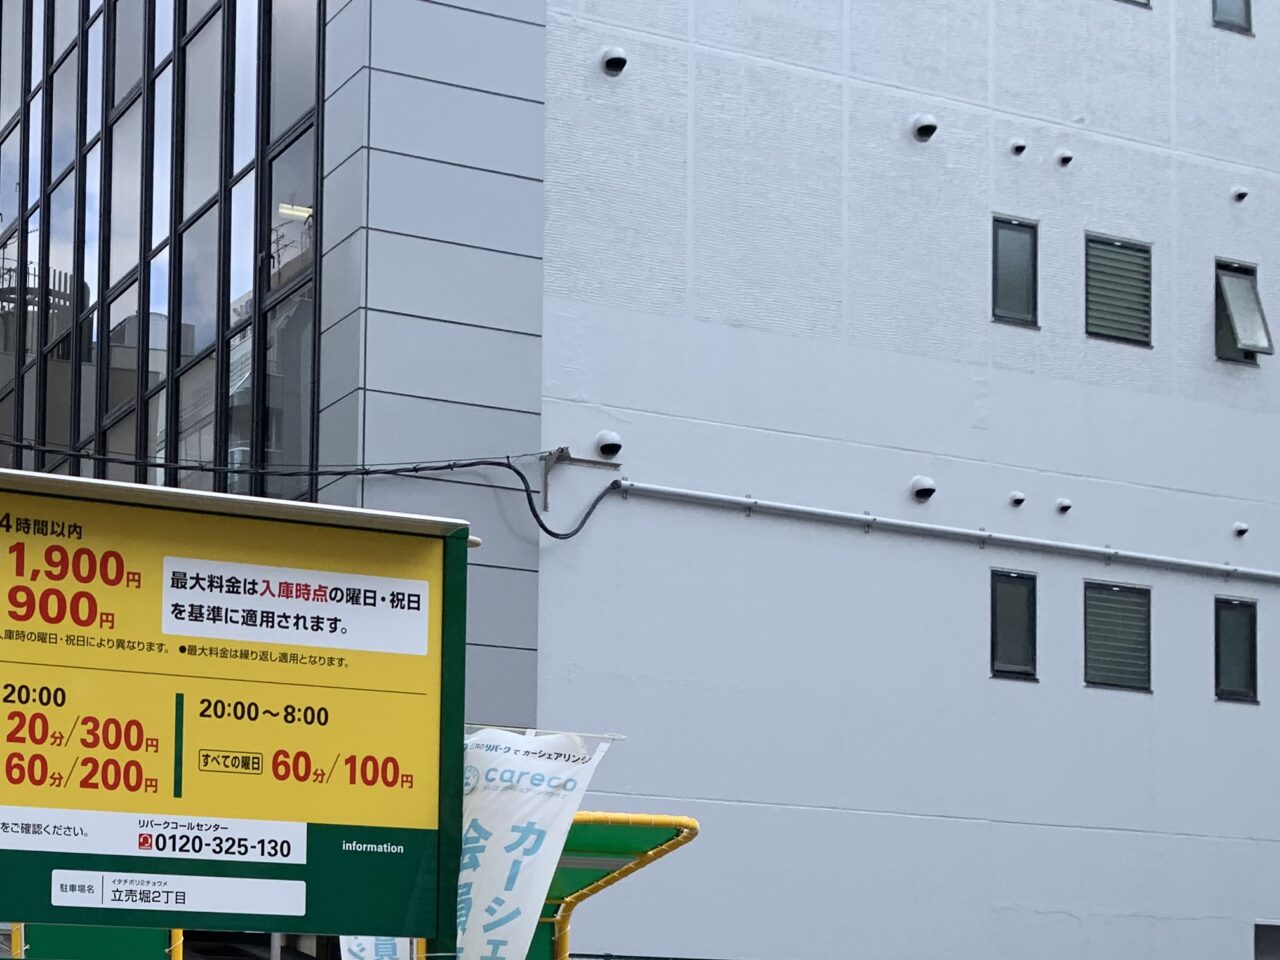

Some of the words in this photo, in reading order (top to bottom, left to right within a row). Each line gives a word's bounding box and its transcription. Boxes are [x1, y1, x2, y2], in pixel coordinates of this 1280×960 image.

[170, 571, 422, 611] 最大料金は入庫時点の曜日・祝日
[170, 602, 348, 634] を基準に適用されます。
[201, 753, 261, 772] すべての曜日
[484, 766, 578, 792] careco
[155, 833, 291, 857] 0120-325-130
[342, 840, 404, 854] information
[59, 883, 95, 894] 駐車場名
[111, 888, 186, 905] 立売堀2丁目
